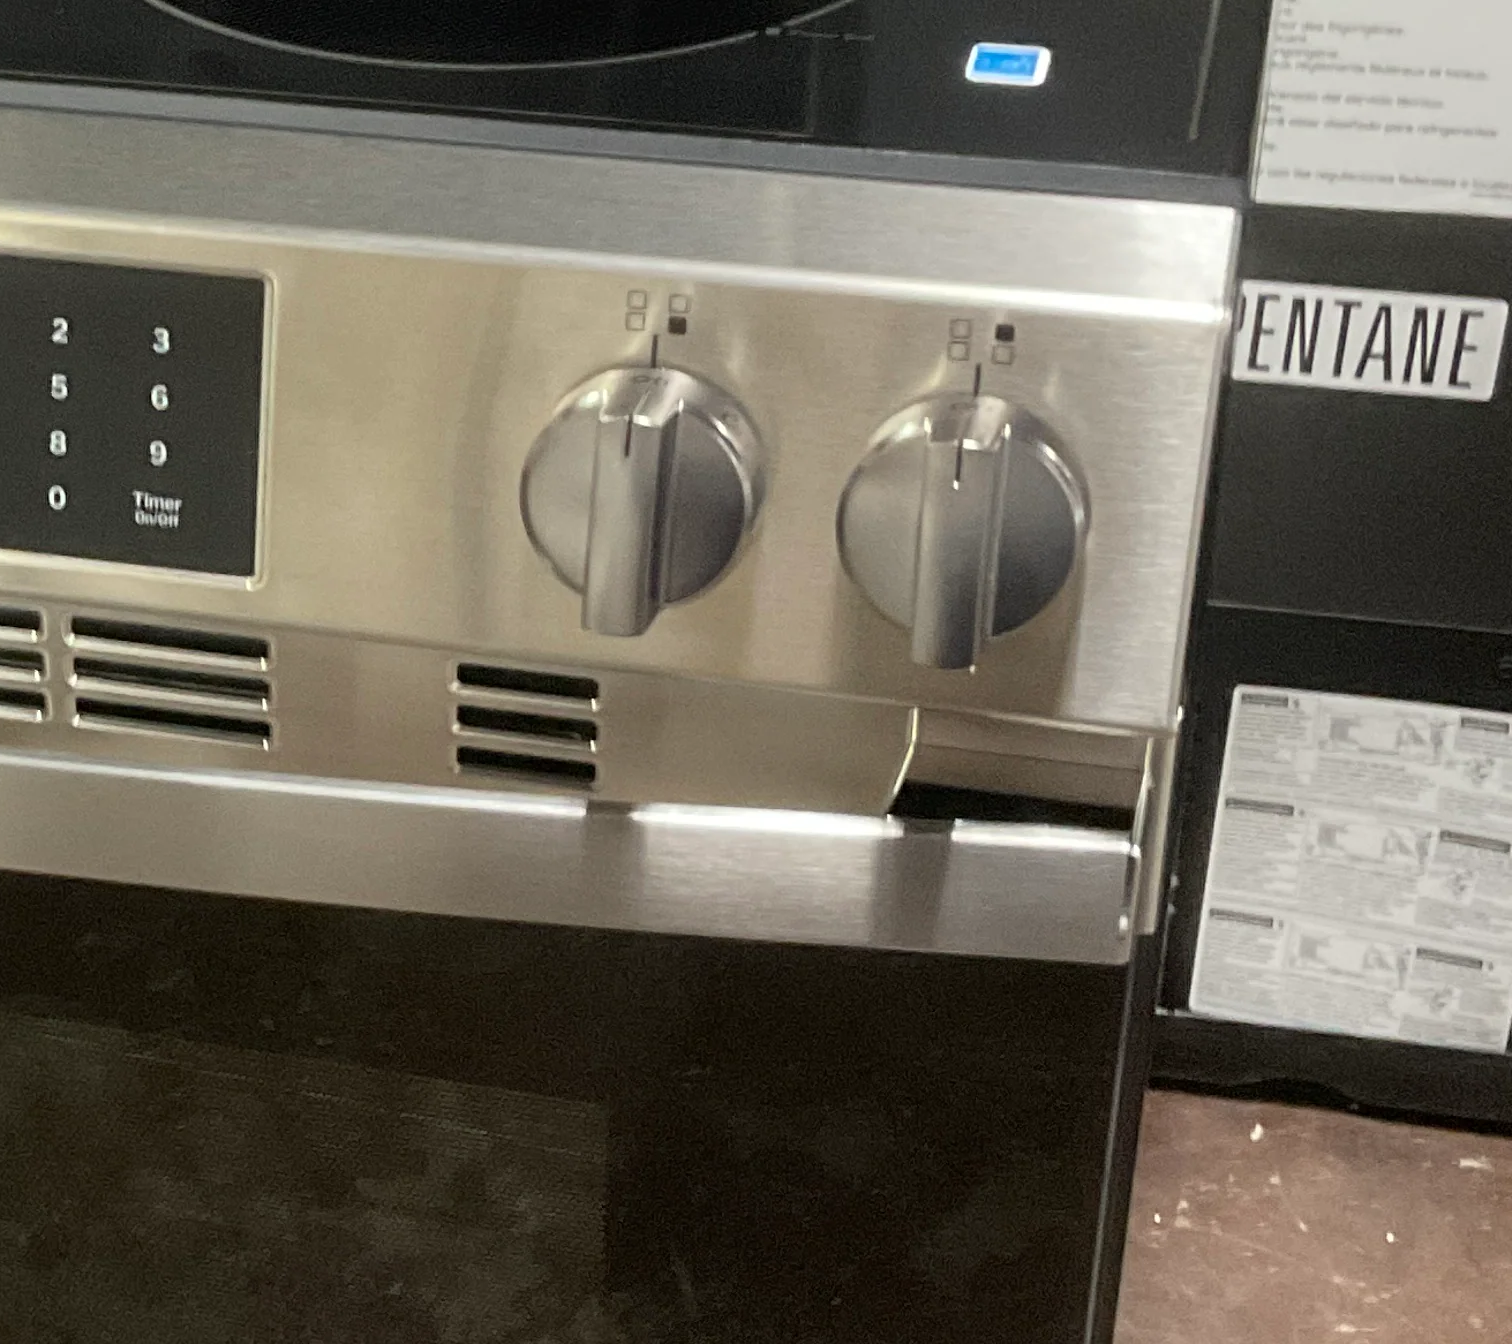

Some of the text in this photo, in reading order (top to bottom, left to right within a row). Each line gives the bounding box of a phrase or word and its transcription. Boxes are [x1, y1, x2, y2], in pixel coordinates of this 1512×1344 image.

[50, 316, 69, 345] 2
[151, 326, 171, 355] 3
[50, 372, 69, 401] 5
[150, 383, 170, 412] 6
[49, 429, 68, 457] 8
[149, 439, 168, 467] 9
[47, 484, 67, 511] 0
[132, 490, 183, 512] Timer
